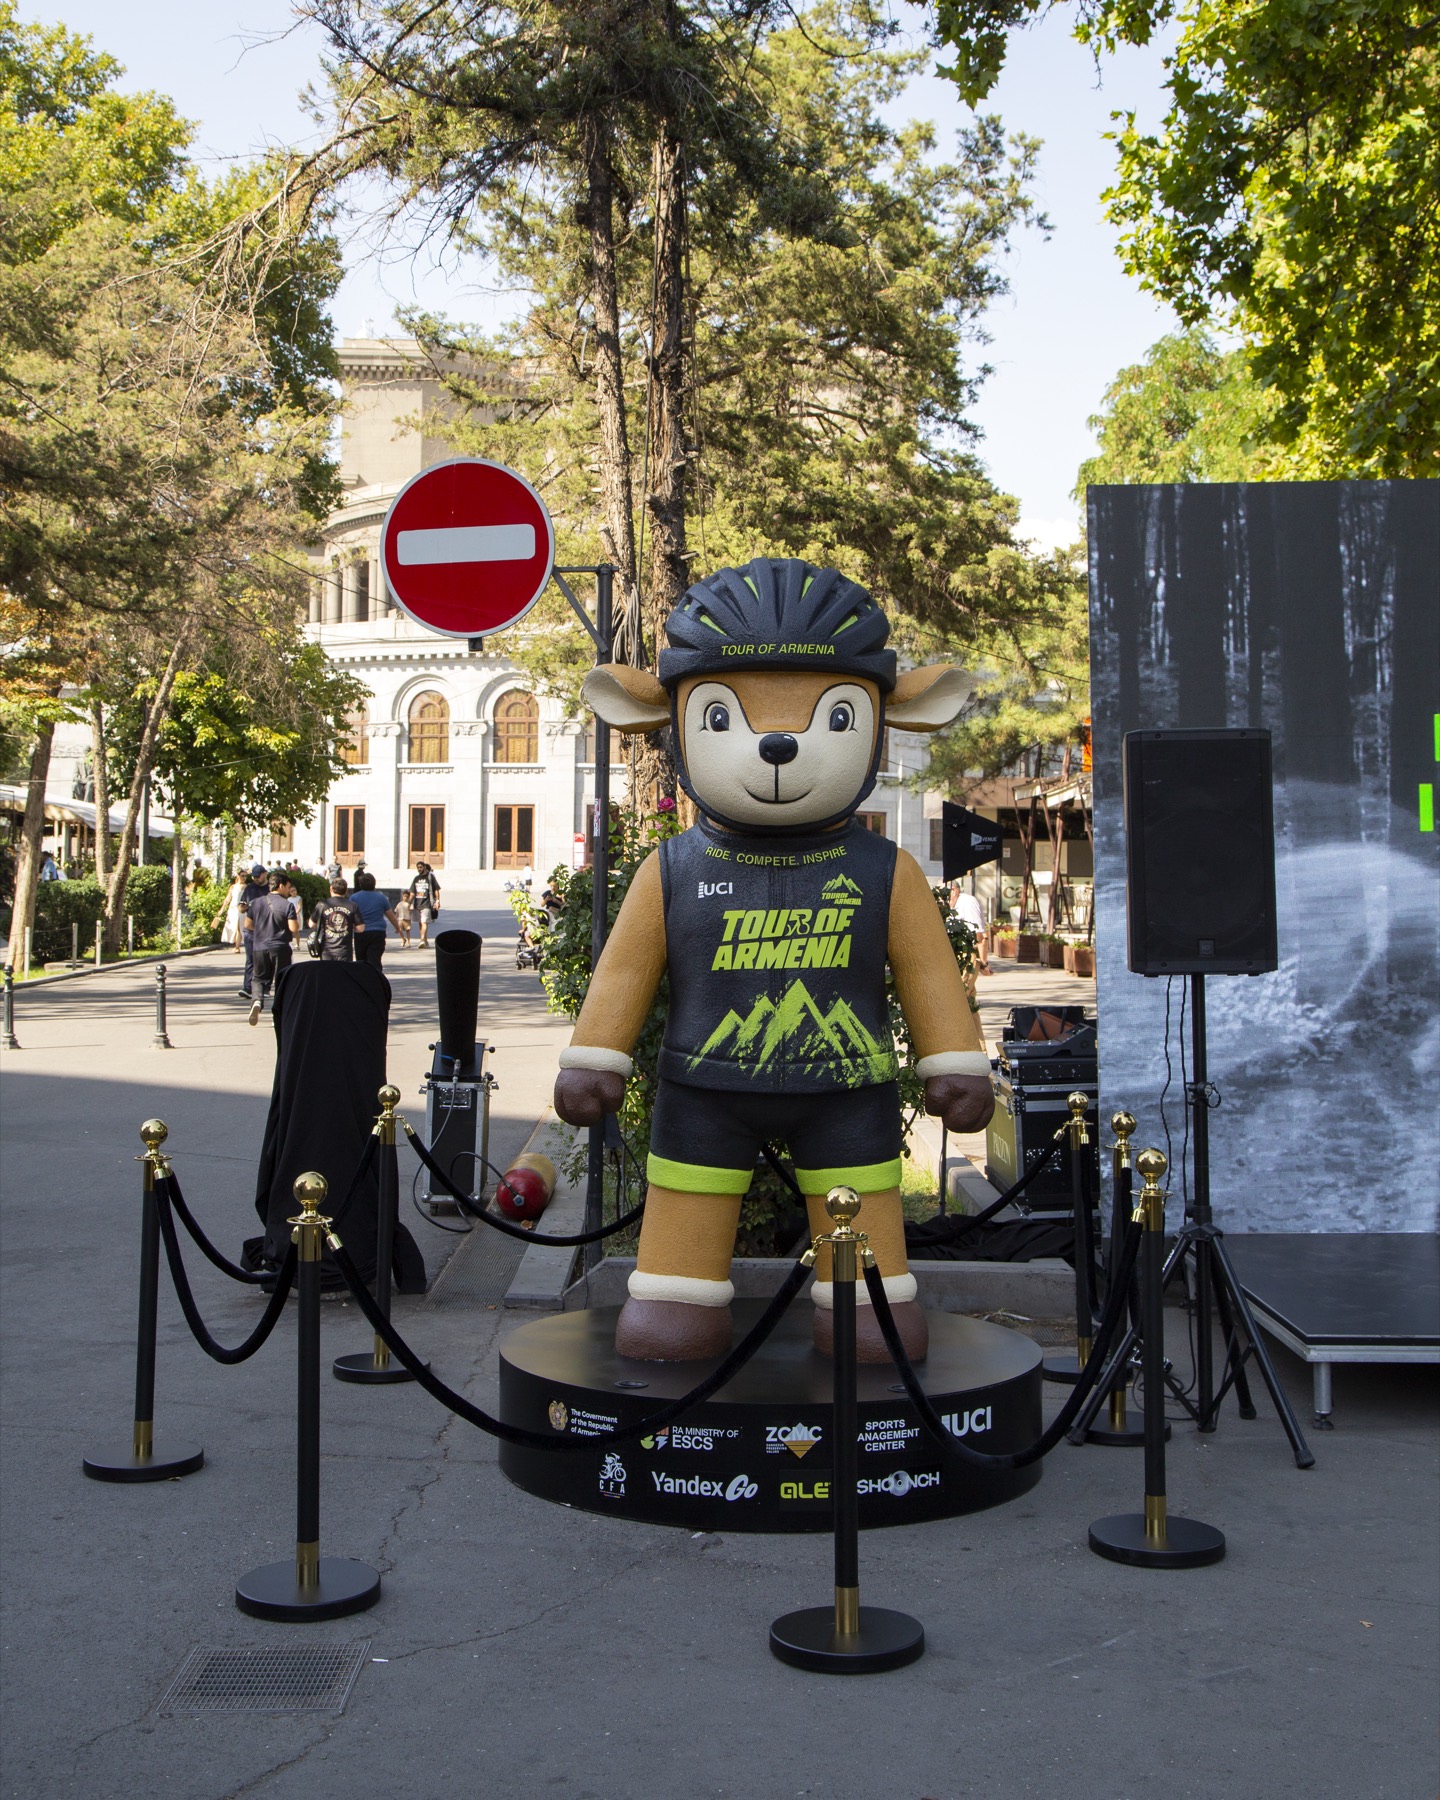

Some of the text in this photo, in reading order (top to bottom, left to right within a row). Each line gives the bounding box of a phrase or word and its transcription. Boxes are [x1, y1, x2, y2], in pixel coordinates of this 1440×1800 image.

[721, 643, 835, 656] TOUR OF ARMENIA
[705, 845, 847, 867] RIDE. COMPETE. INSPIRE
[703, 882, 733, 897] UCI
[833, 897, 862, 906] ARMENIA
[722, 908, 855, 942] TOUR OF
[711, 934, 852, 971] ARMENIA
[570, 1408, 618, 1424] The Government
[951, 1406, 992, 1437] UCI
[577, 1419, 587, 1427] the
[588, 1421, 615, 1432] Republic
[672, 1426, 739, 1438] RA MINISTRY OF
[865, 1419, 906, 1431] SPORTS
[765, 1426, 823, 1442] ZCMC
[857, 1428, 920, 1442] ANAGEMENT
[672, 1434, 714, 1451] ESCS
[865, 1440, 906, 1452] CENTER
[651, 1471, 759, 1501] Yandex Go
